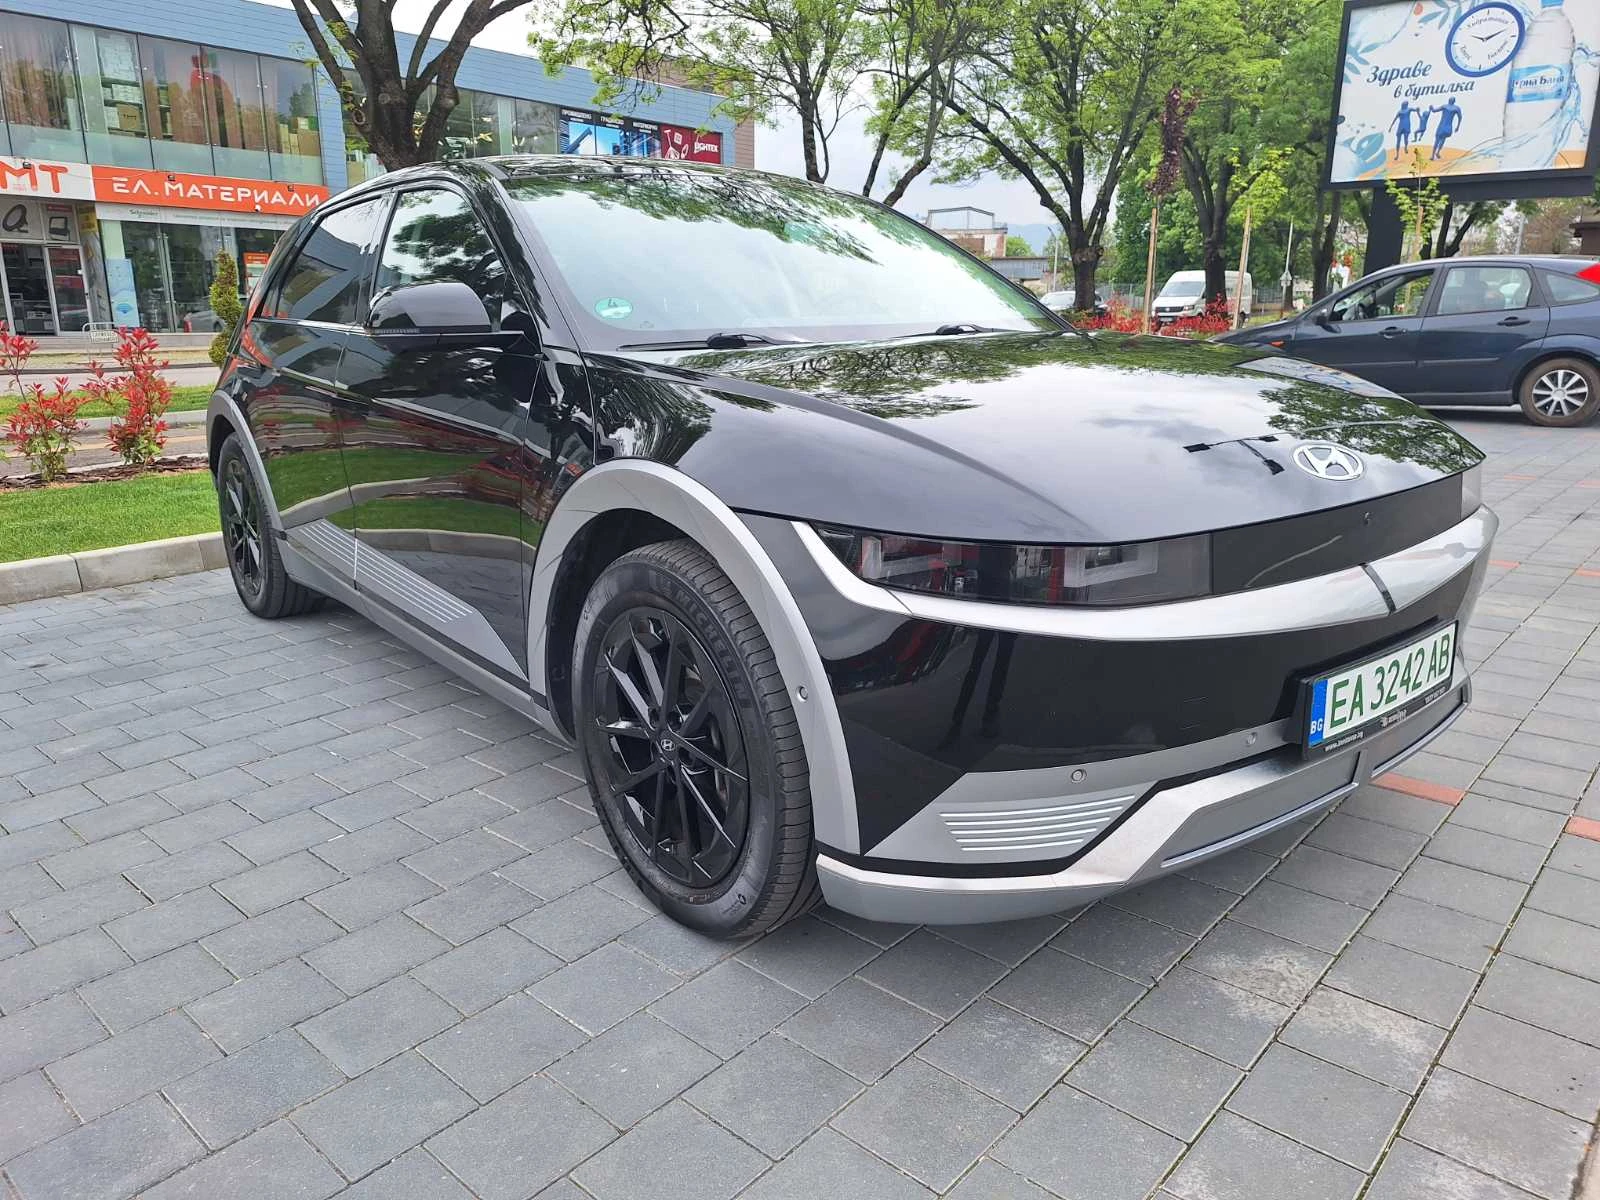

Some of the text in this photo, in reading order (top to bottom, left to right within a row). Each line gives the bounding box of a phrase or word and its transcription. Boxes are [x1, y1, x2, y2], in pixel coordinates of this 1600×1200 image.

[1366, 60, 1432, 87] Здраве
[1393, 81, 1475, 100] в бутилка
[164, 181, 320, 207] МАТЕРИАЛИ
[1330, 633, 1450, 728] EA 3242 AB
[1310, 718, 1323, 735] BG
